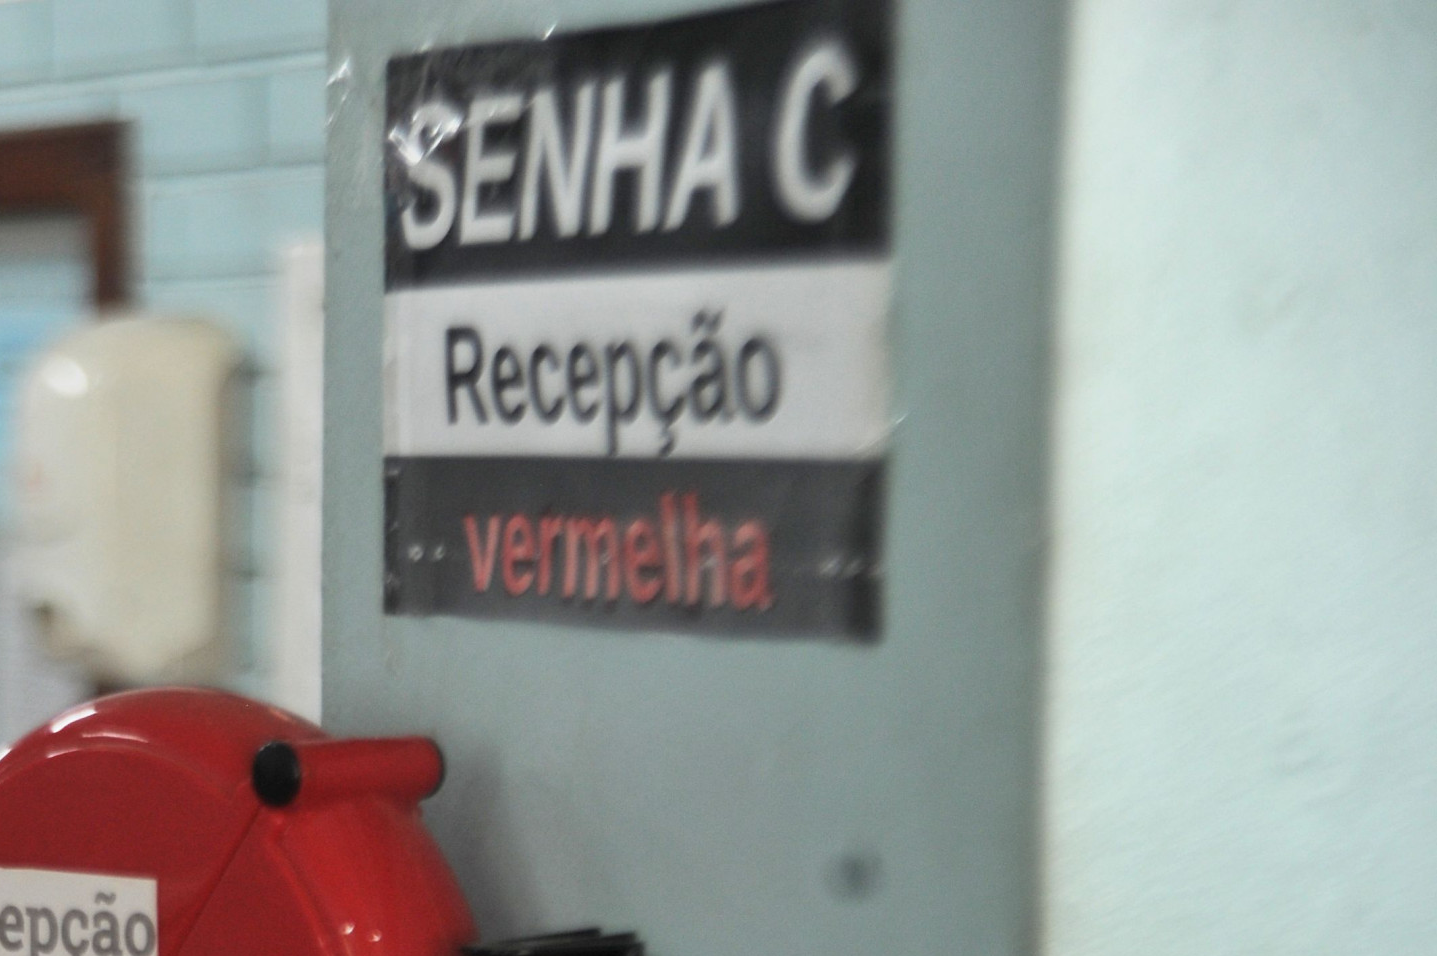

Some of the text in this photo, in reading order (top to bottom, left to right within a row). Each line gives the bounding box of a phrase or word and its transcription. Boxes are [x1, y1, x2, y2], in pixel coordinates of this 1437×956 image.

[394, 36, 860, 250] SENHA C
[444, 306, 784, 457] Recepção
[464, 488, 775, 612] vermelha
